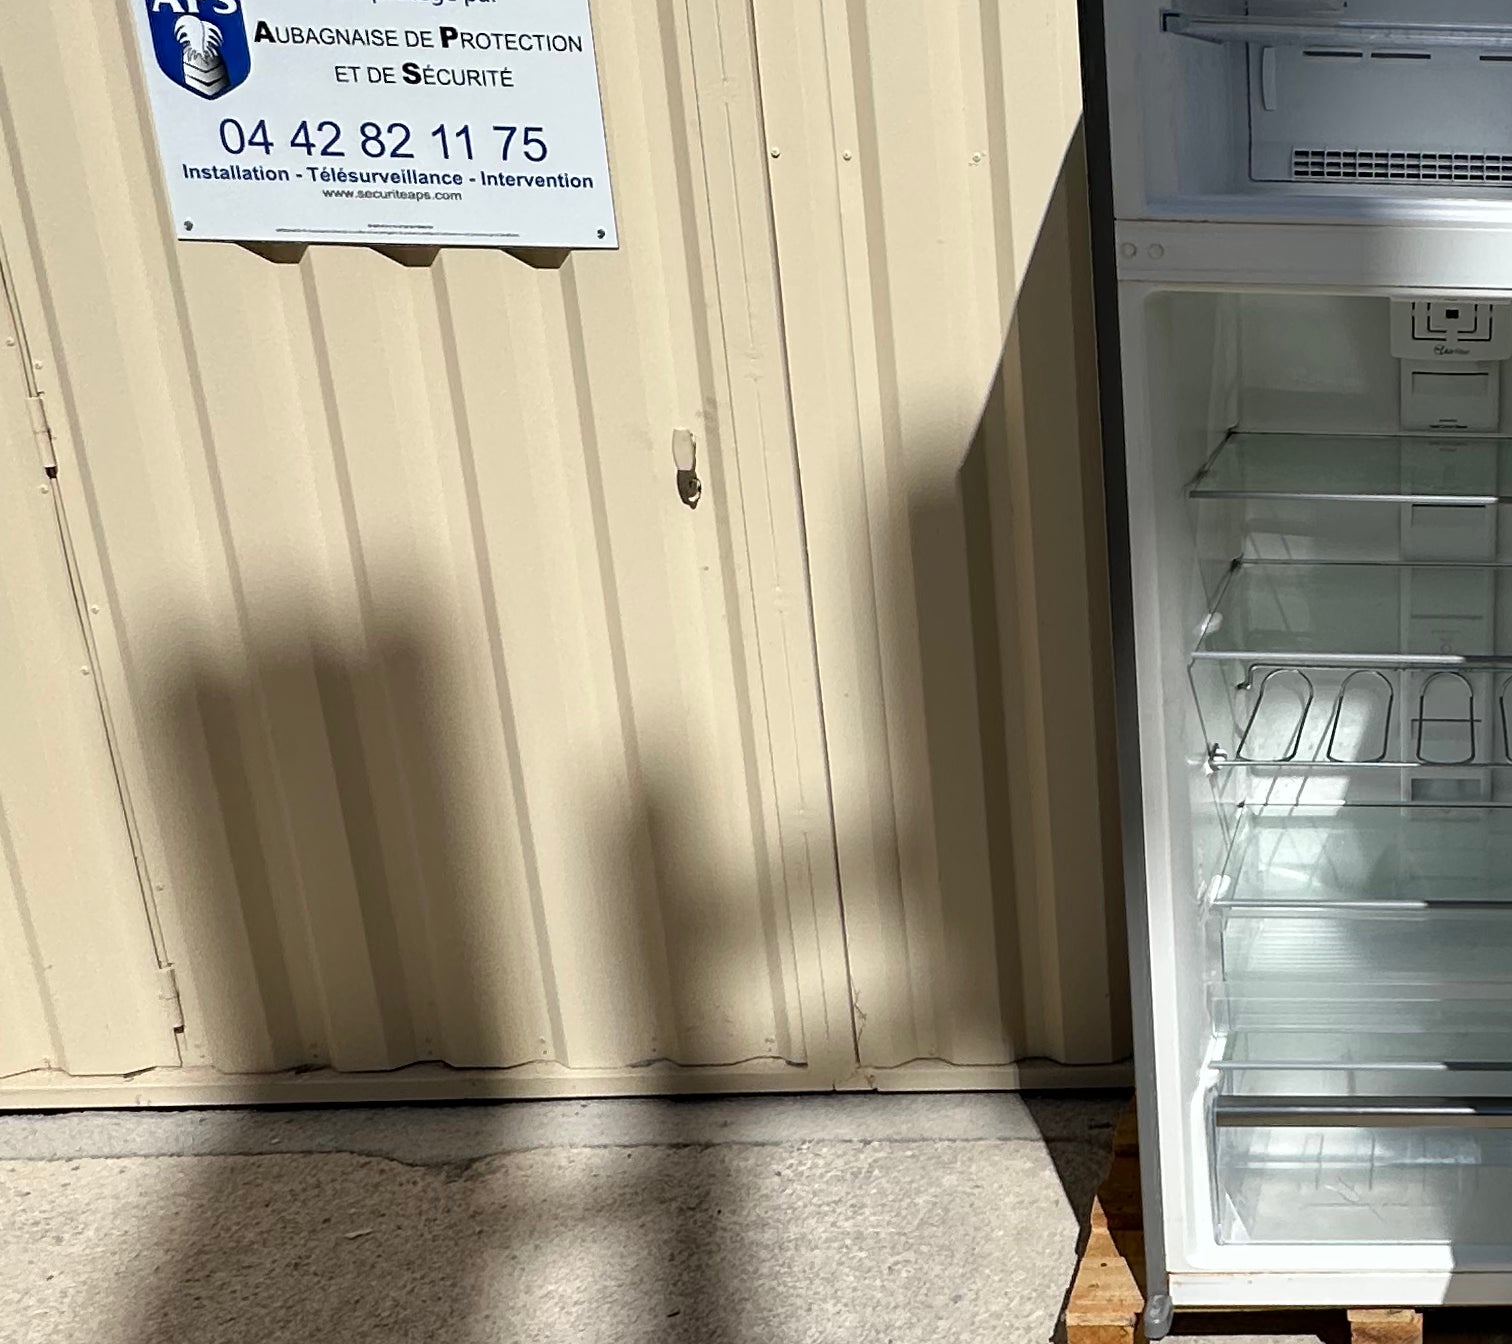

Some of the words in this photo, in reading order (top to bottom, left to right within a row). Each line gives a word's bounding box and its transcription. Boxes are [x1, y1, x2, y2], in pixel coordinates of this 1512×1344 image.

[254, 20, 399, 47] AUBAGNAISE
[405, 30, 434, 48] DE
[439, 26, 583, 52] PROTECTION
[335, 65, 360, 83] ET
[367, 66, 397, 84] DE
[402, 62, 514, 87] SÉCURITÉ
[219, 118, 274, 155] 04
[290, 120, 345, 157] 42
[360, 122, 414, 159] 82
[431, 124, 473, 160] 11
[493, 125, 547, 162] 75
[182, 163, 290, 181] Installation
[306, 166, 463, 185] Télésurveillance
[480, 170, 594, 188] Intervention
[322, 188, 462, 201] www.securiteaps.com
